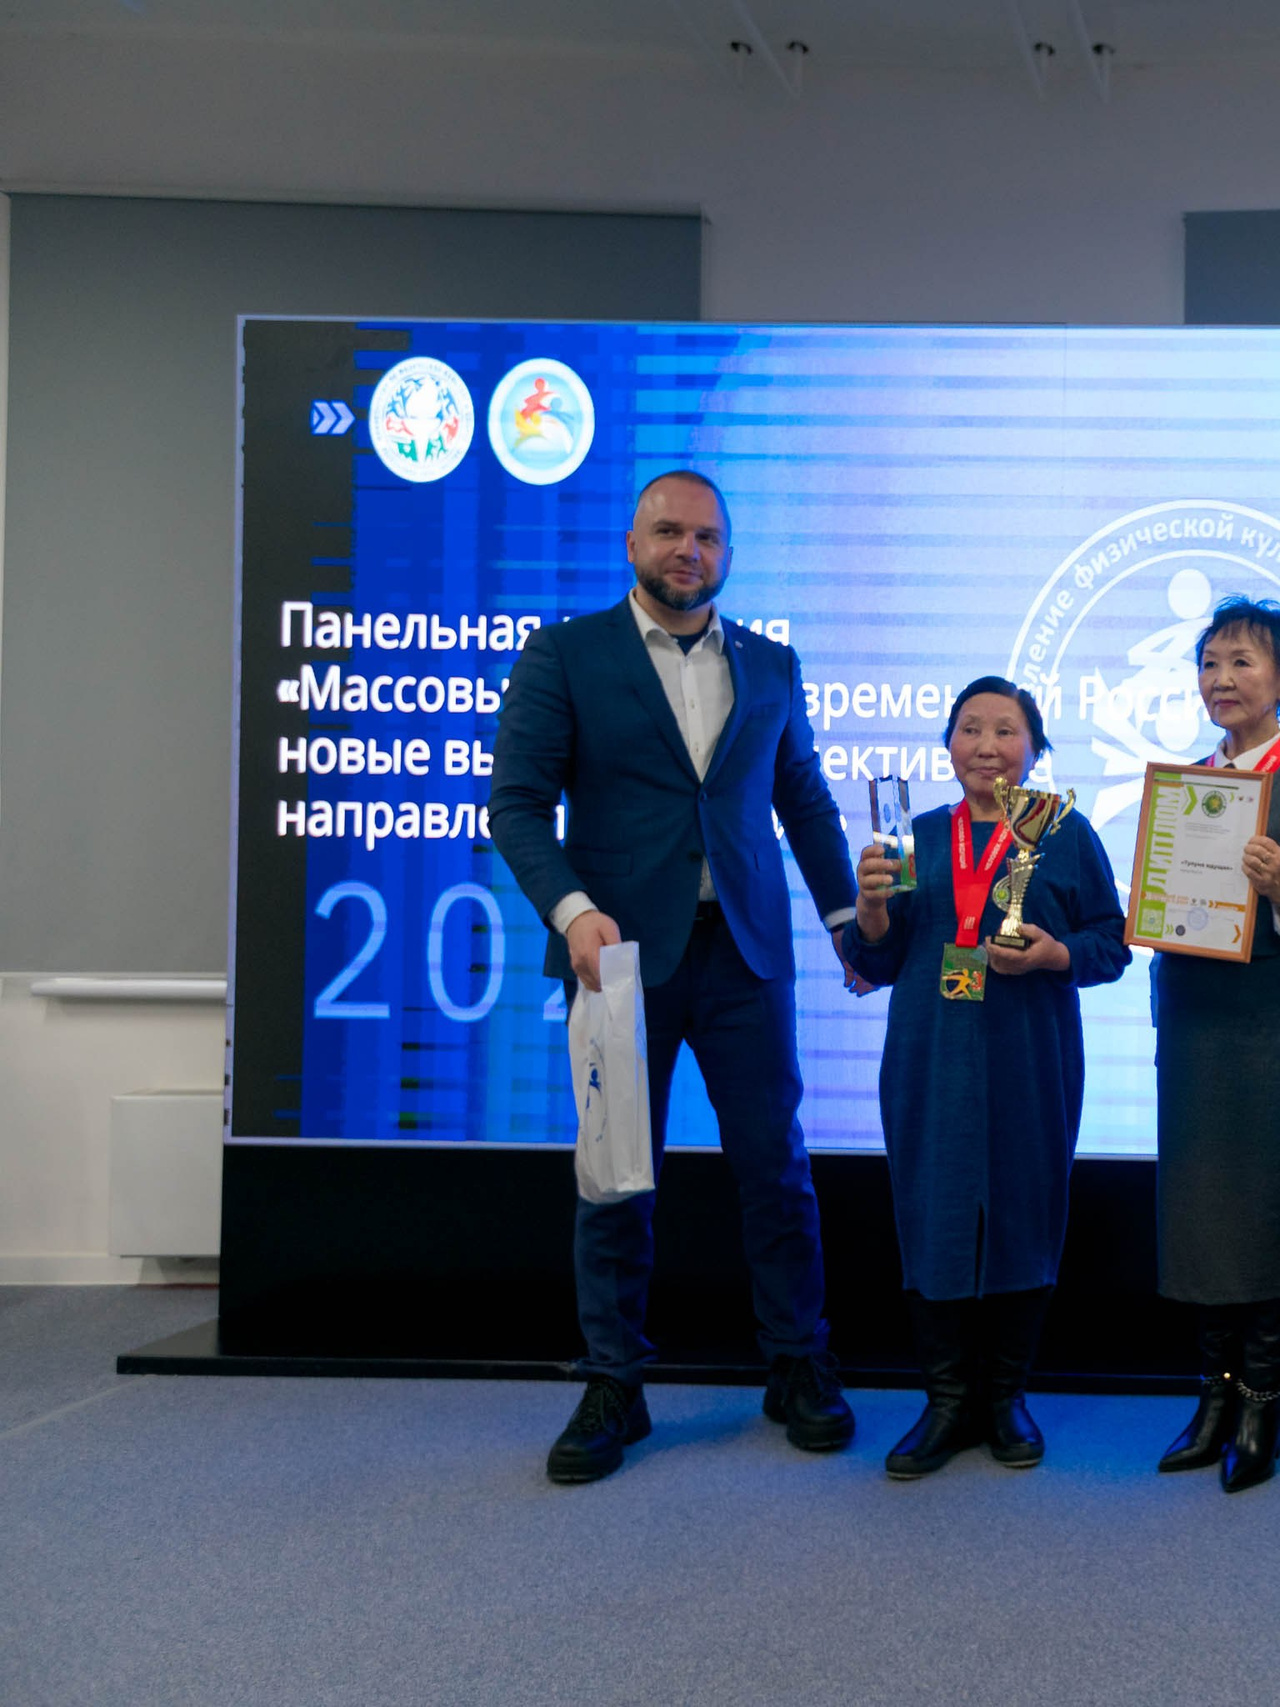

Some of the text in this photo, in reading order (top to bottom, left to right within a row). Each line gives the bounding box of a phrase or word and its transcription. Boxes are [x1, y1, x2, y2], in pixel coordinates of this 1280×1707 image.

[1073, 513, 1235, 592] физической
[280, 600, 541, 651] Панельная
[276, 663, 510, 713] «Массовы
[277, 736, 431, 776] новые
